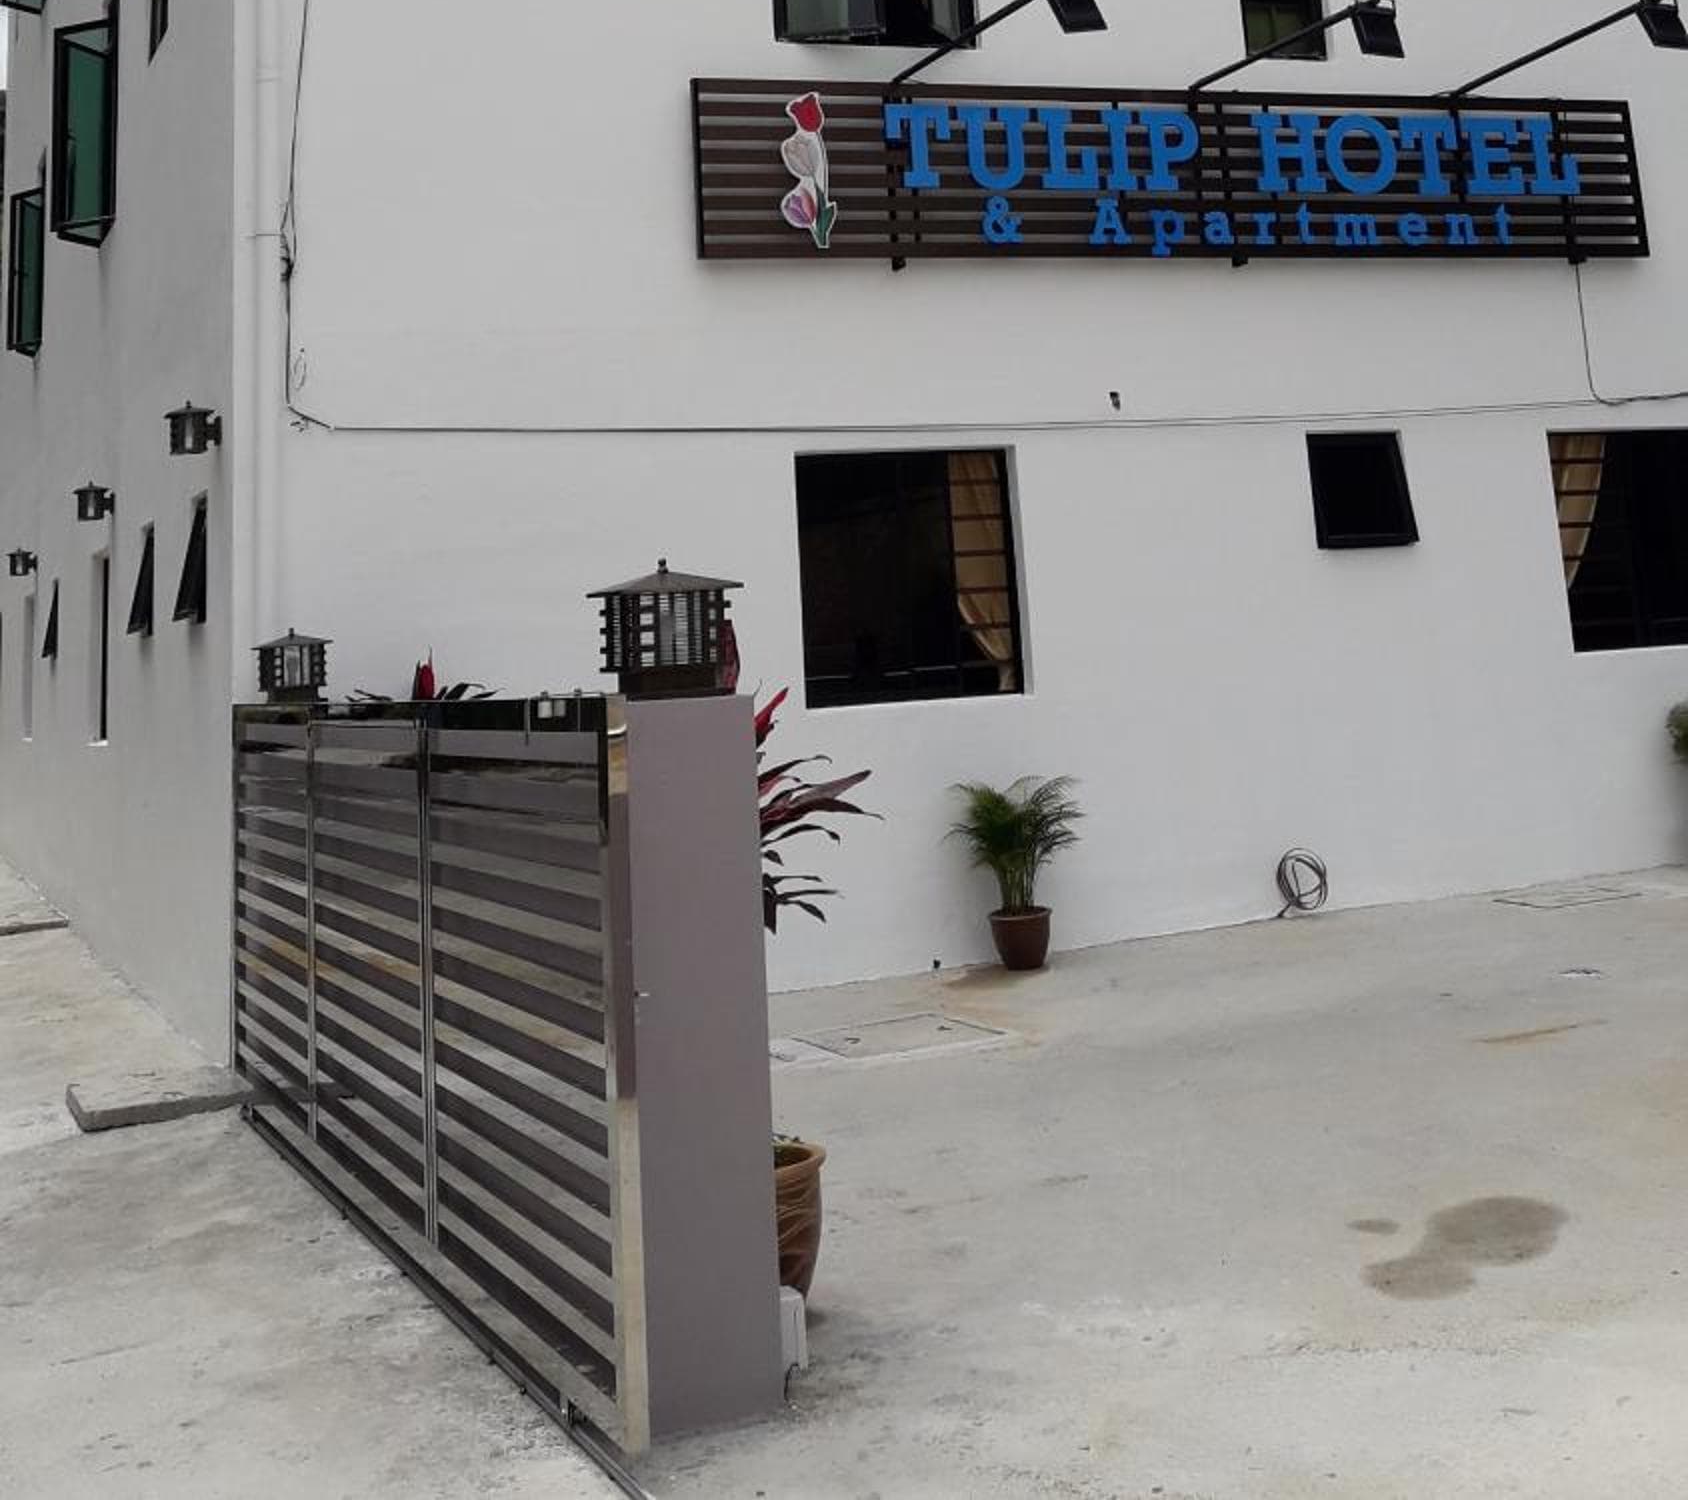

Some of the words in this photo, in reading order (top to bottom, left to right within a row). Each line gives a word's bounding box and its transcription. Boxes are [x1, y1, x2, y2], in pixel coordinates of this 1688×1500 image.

[884, 104, 1199, 192] TULIP
[1251, 112, 1581, 197] HOTEL
[983, 196, 1024, 244] &
[1089, 197, 1513, 257] Apartment
